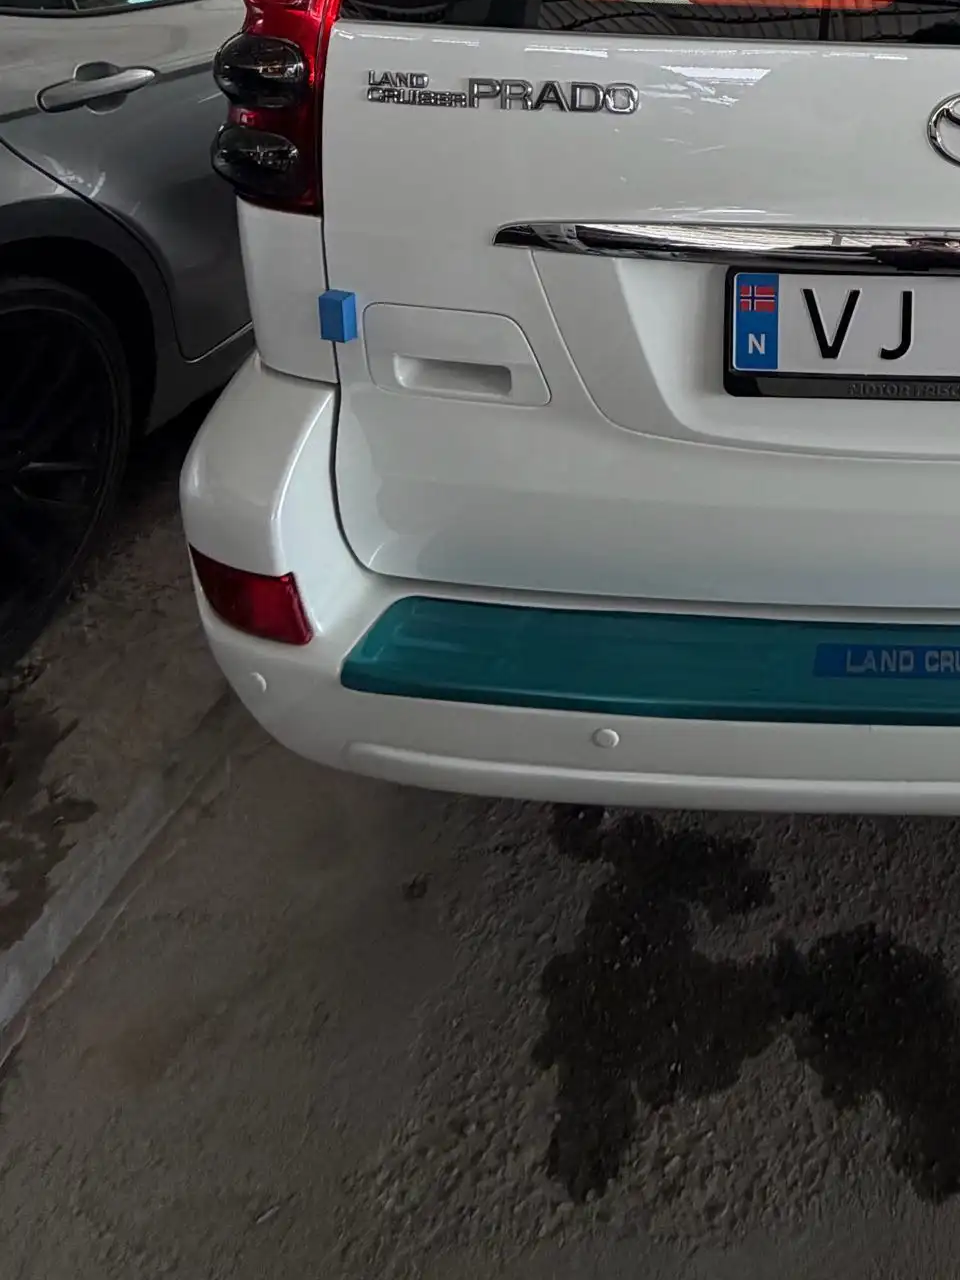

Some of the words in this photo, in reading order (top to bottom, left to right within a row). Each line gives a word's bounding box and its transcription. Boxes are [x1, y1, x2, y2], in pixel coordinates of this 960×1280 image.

[368, 70, 429, 89] LAND
[468, 77, 640, 115] PRADO
[803, 288, 912, 360] VJ
[747, 333, 766, 355] N
[845, 649, 915, 673] LAND
